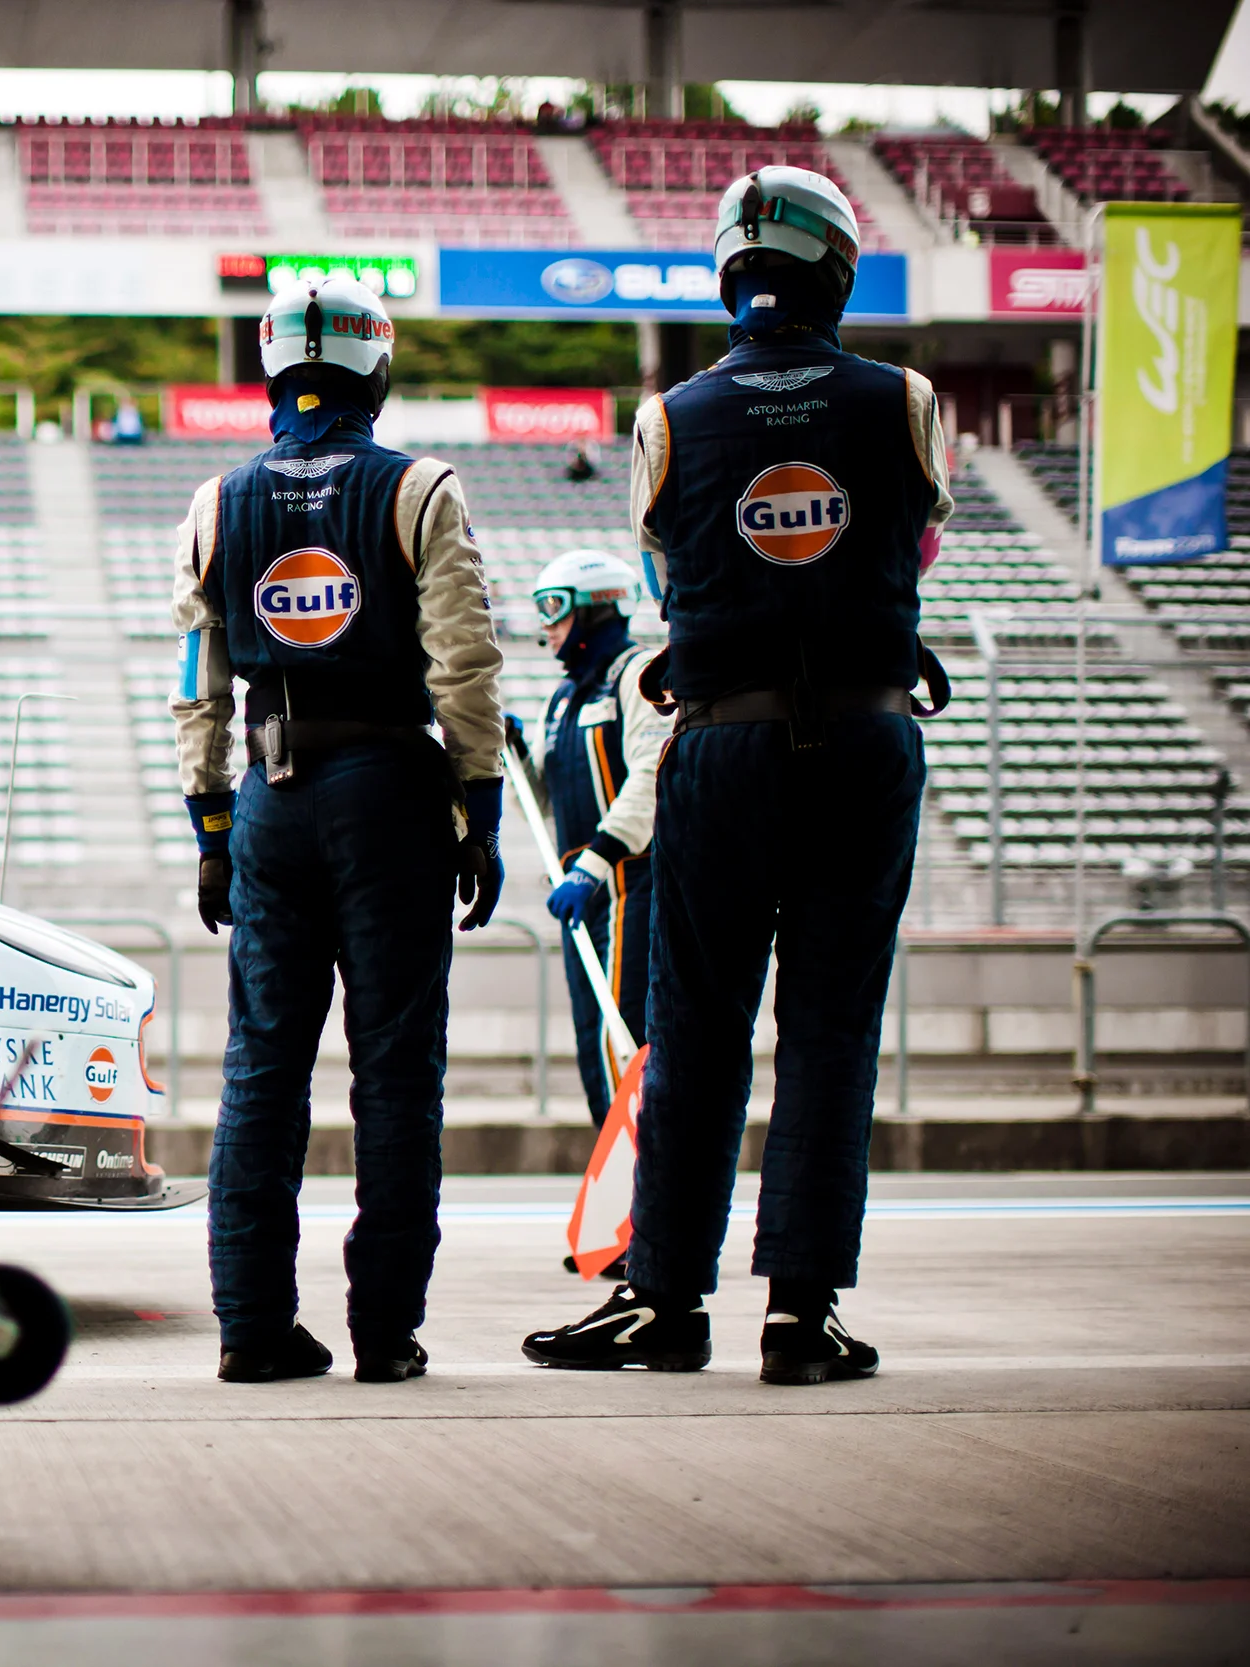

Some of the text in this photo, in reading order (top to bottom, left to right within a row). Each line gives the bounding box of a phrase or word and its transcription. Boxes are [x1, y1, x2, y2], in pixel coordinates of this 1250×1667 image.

[746, 400, 828, 415] ASTON MARTIN
[766, 413, 810, 426] RACING
[271, 485, 342, 501] ASTON MARTIN
[287, 500, 324, 512] RACING
[741, 495, 846, 533] Gulf
[260, 581, 356, 614] Gulf
[94, 996, 131, 1023] Solar
[85, 1065, 118, 1085] Gulf
[96, 1149, 135, 1169] Ontime
